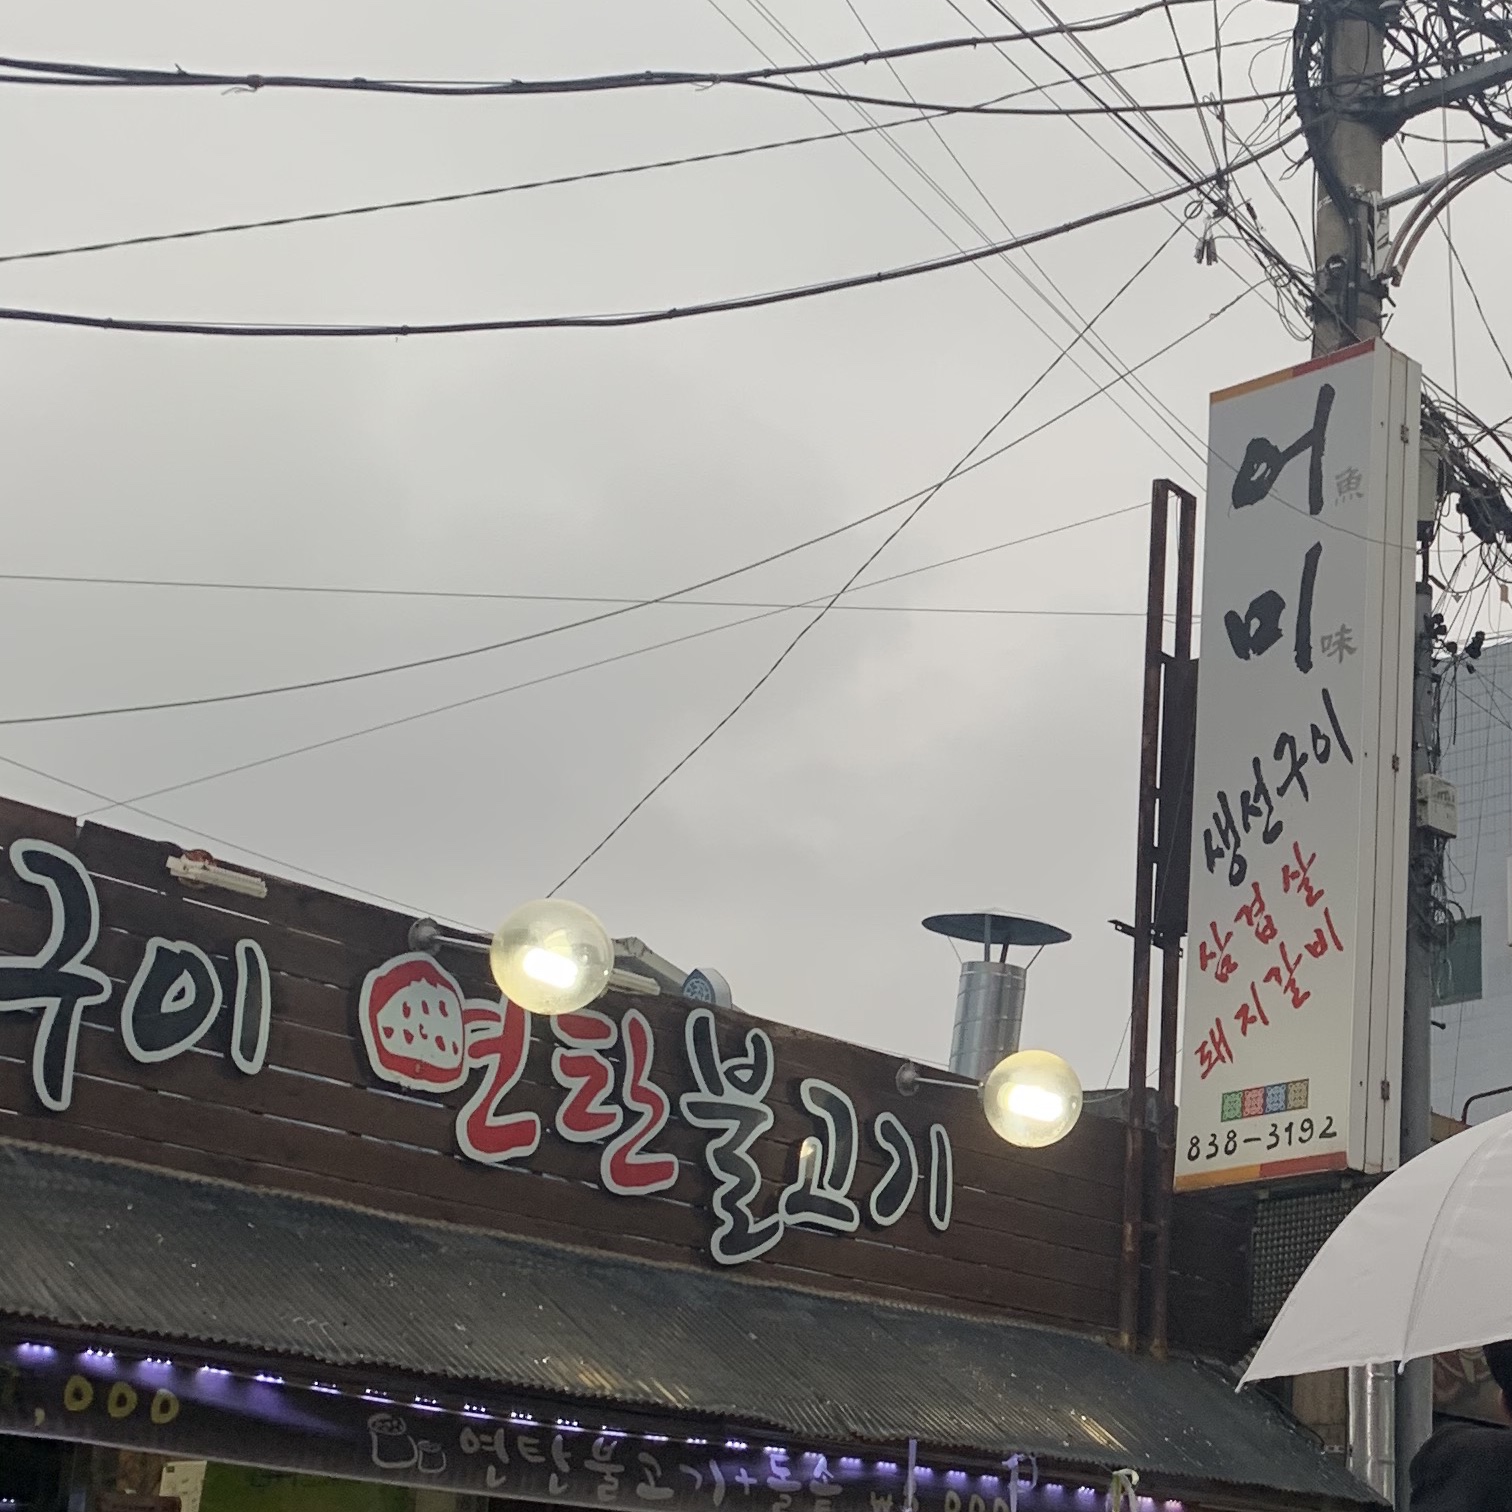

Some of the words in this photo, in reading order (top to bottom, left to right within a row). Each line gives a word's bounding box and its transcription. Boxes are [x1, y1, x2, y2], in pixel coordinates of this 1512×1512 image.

[1204, 688, 1353, 886] 생선구이
[1195, 907, 1344, 1080] 돼지갈비
[1200, 841, 1325, 983] 삼겹살
[0, 838, 272, 1112] 구이
[359, 952, 953, 1265] 연탄불고기
[1187, 1115, 1338, 1162] 838-3192
